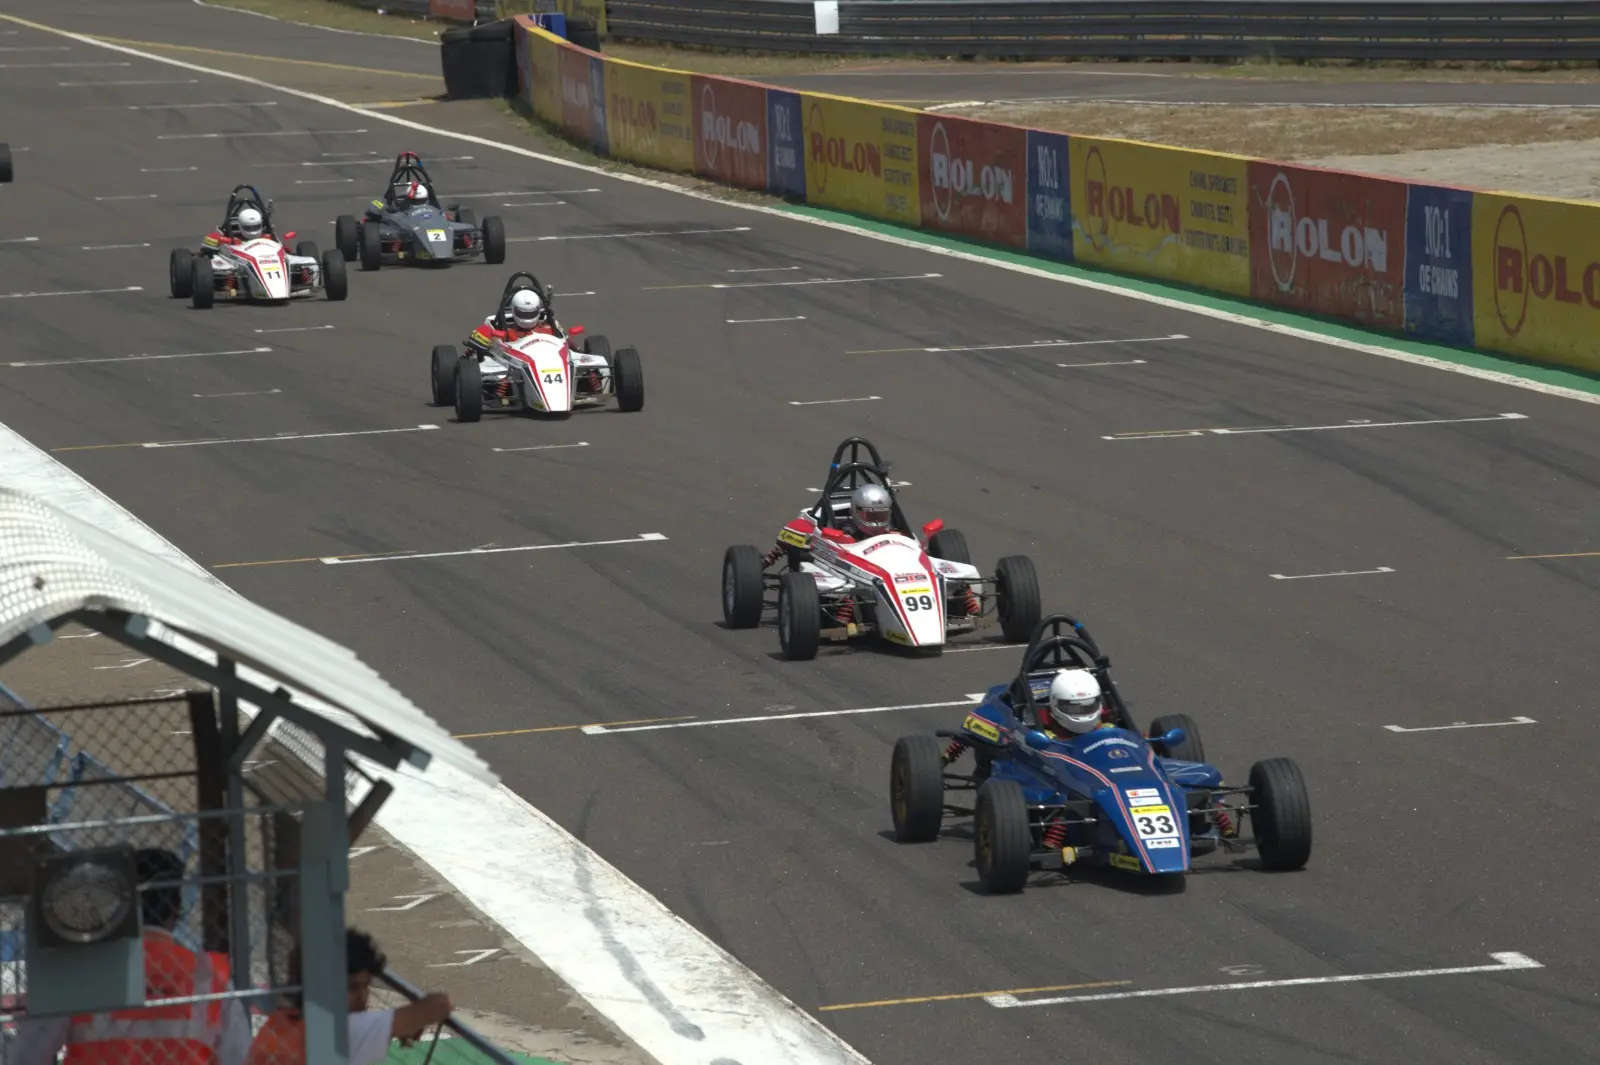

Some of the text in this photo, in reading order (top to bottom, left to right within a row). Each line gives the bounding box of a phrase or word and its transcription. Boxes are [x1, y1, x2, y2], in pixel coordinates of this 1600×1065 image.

[703, 110, 760, 154] ROLON
[811, 132, 881, 177] ROLON
[932, 152, 1013, 204] ROLON
[1087, 179, 1181, 233] ROLON
[1270, 207, 1388, 273] ROLON
[266, 271, 281, 279] 11
[543, 374, 564, 384] 44
[905, 595, 932, 612] 99
[1138, 815, 1174, 835] 33
